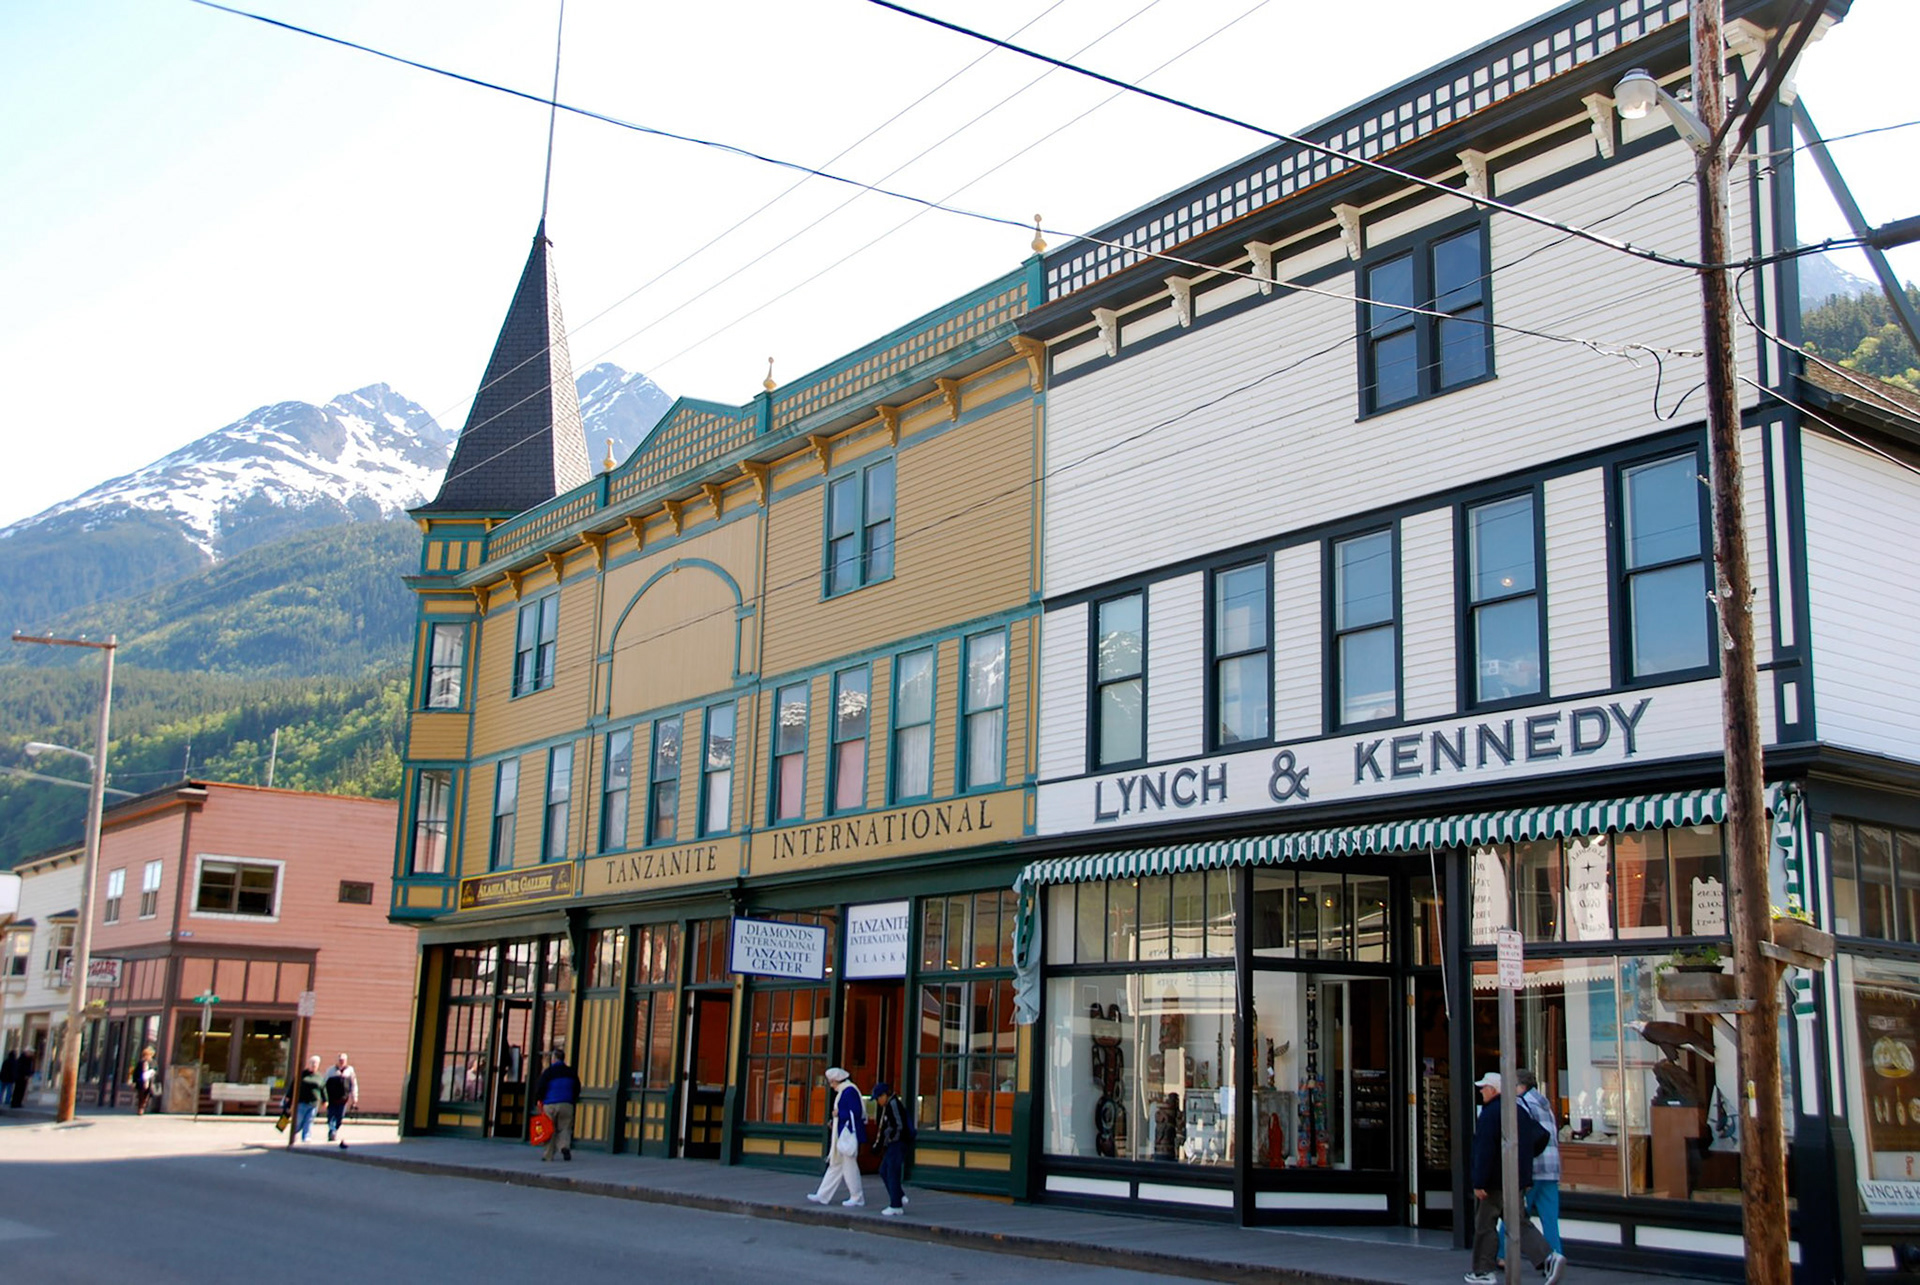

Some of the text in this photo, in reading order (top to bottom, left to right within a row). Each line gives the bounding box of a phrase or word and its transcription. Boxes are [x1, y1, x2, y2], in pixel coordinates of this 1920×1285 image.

[1094, 697, 1654, 824] LYNCH & KENNEDY
[772, 799, 993, 861] INTERNATIONAL
[606, 844, 719, 885] TANZANITE
[746, 924, 814, 941] DIAMONDS
[851, 915, 909, 934] TANZANITE
[740, 936, 817, 952] INTERNATIONAL
[851, 933, 907, 947] INTERNATIONA
[744, 946, 812, 964] TANZANITE
[854, 951, 907, 965] ALASKA
[752, 958, 803, 974] CENTER
[1861, 1183, 1904, 1199] LYNCH
[1903, 1185, 1914, 1200] &
